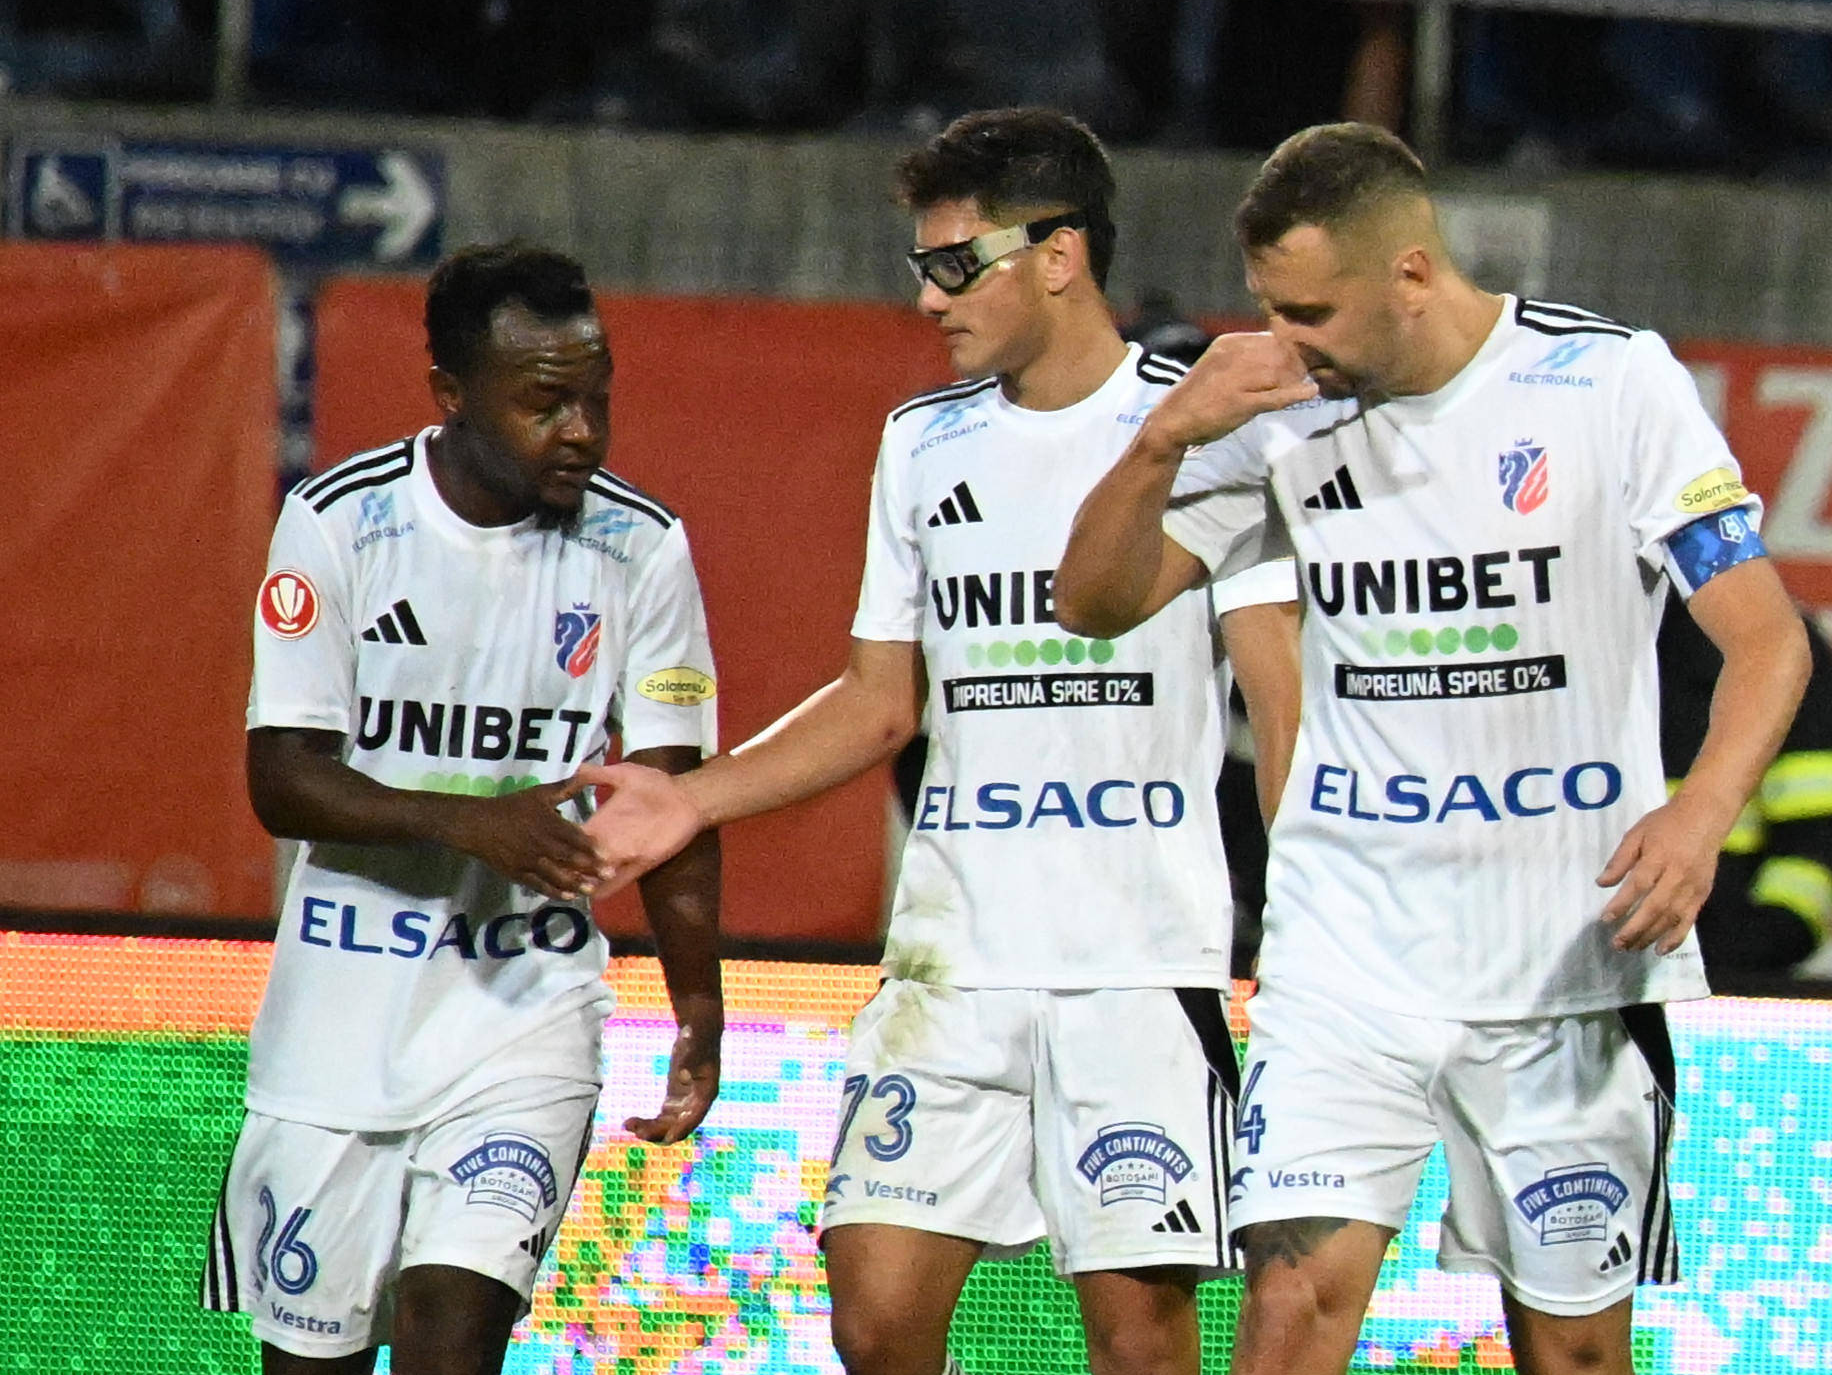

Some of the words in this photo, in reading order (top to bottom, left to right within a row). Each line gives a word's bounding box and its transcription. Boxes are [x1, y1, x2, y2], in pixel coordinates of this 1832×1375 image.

[1309, 545, 1561, 617] UNIBET
[1051, 679, 1099, 704] SPRE
[1105, 678, 1141, 703] 0%
[1447, 670, 1506, 695] SPRE
[1512, 667, 1551, 690] 0%
[356, 696, 591, 764] UNIBET
[916, 778, 1185, 832] ELSACO
[1310, 760, 1623, 824] ELSACO
[300, 895, 591, 961] ELSACO
[864, 1179, 938, 1207] Vestra
[1268, 1169, 1345, 1188] Vestra
[271, 1301, 341, 1334] Vestra
